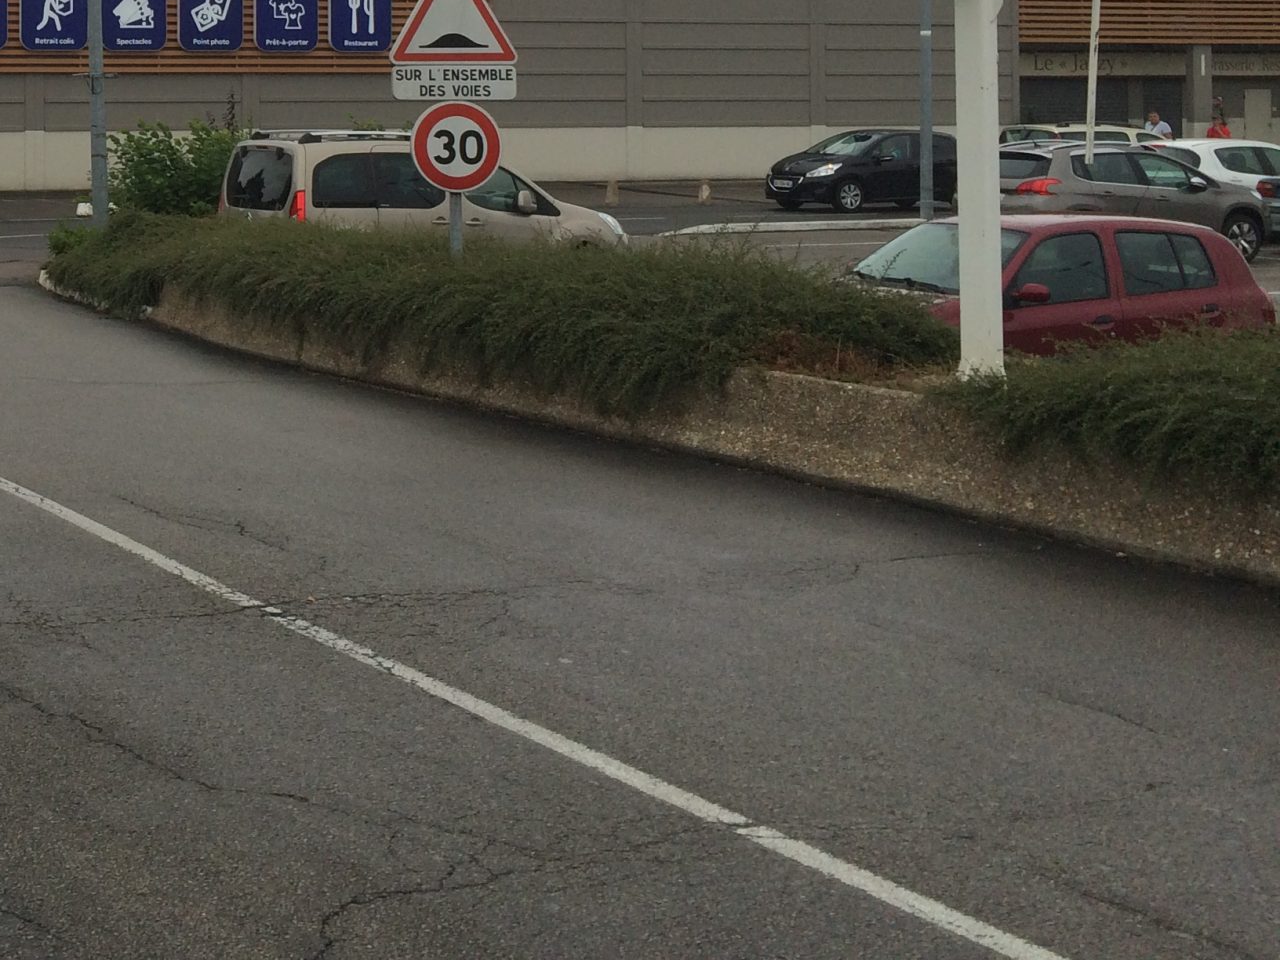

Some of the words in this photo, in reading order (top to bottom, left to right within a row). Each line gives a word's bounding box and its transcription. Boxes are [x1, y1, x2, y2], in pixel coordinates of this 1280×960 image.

[34, 37, 58, 45] Retrait
[116, 38, 152, 46] Spectacles
[211, 38, 230, 46] photo
[344, 39, 378, 47] Restaurant
[1034, 54, 1054, 71] Le
[1071, 54, 1114, 74] Jazy
[395, 69, 422, 81] SUR
[419, 85, 446, 97] DES
[452, 85, 492, 97] VOIES
[433, 129, 484, 165] 30
